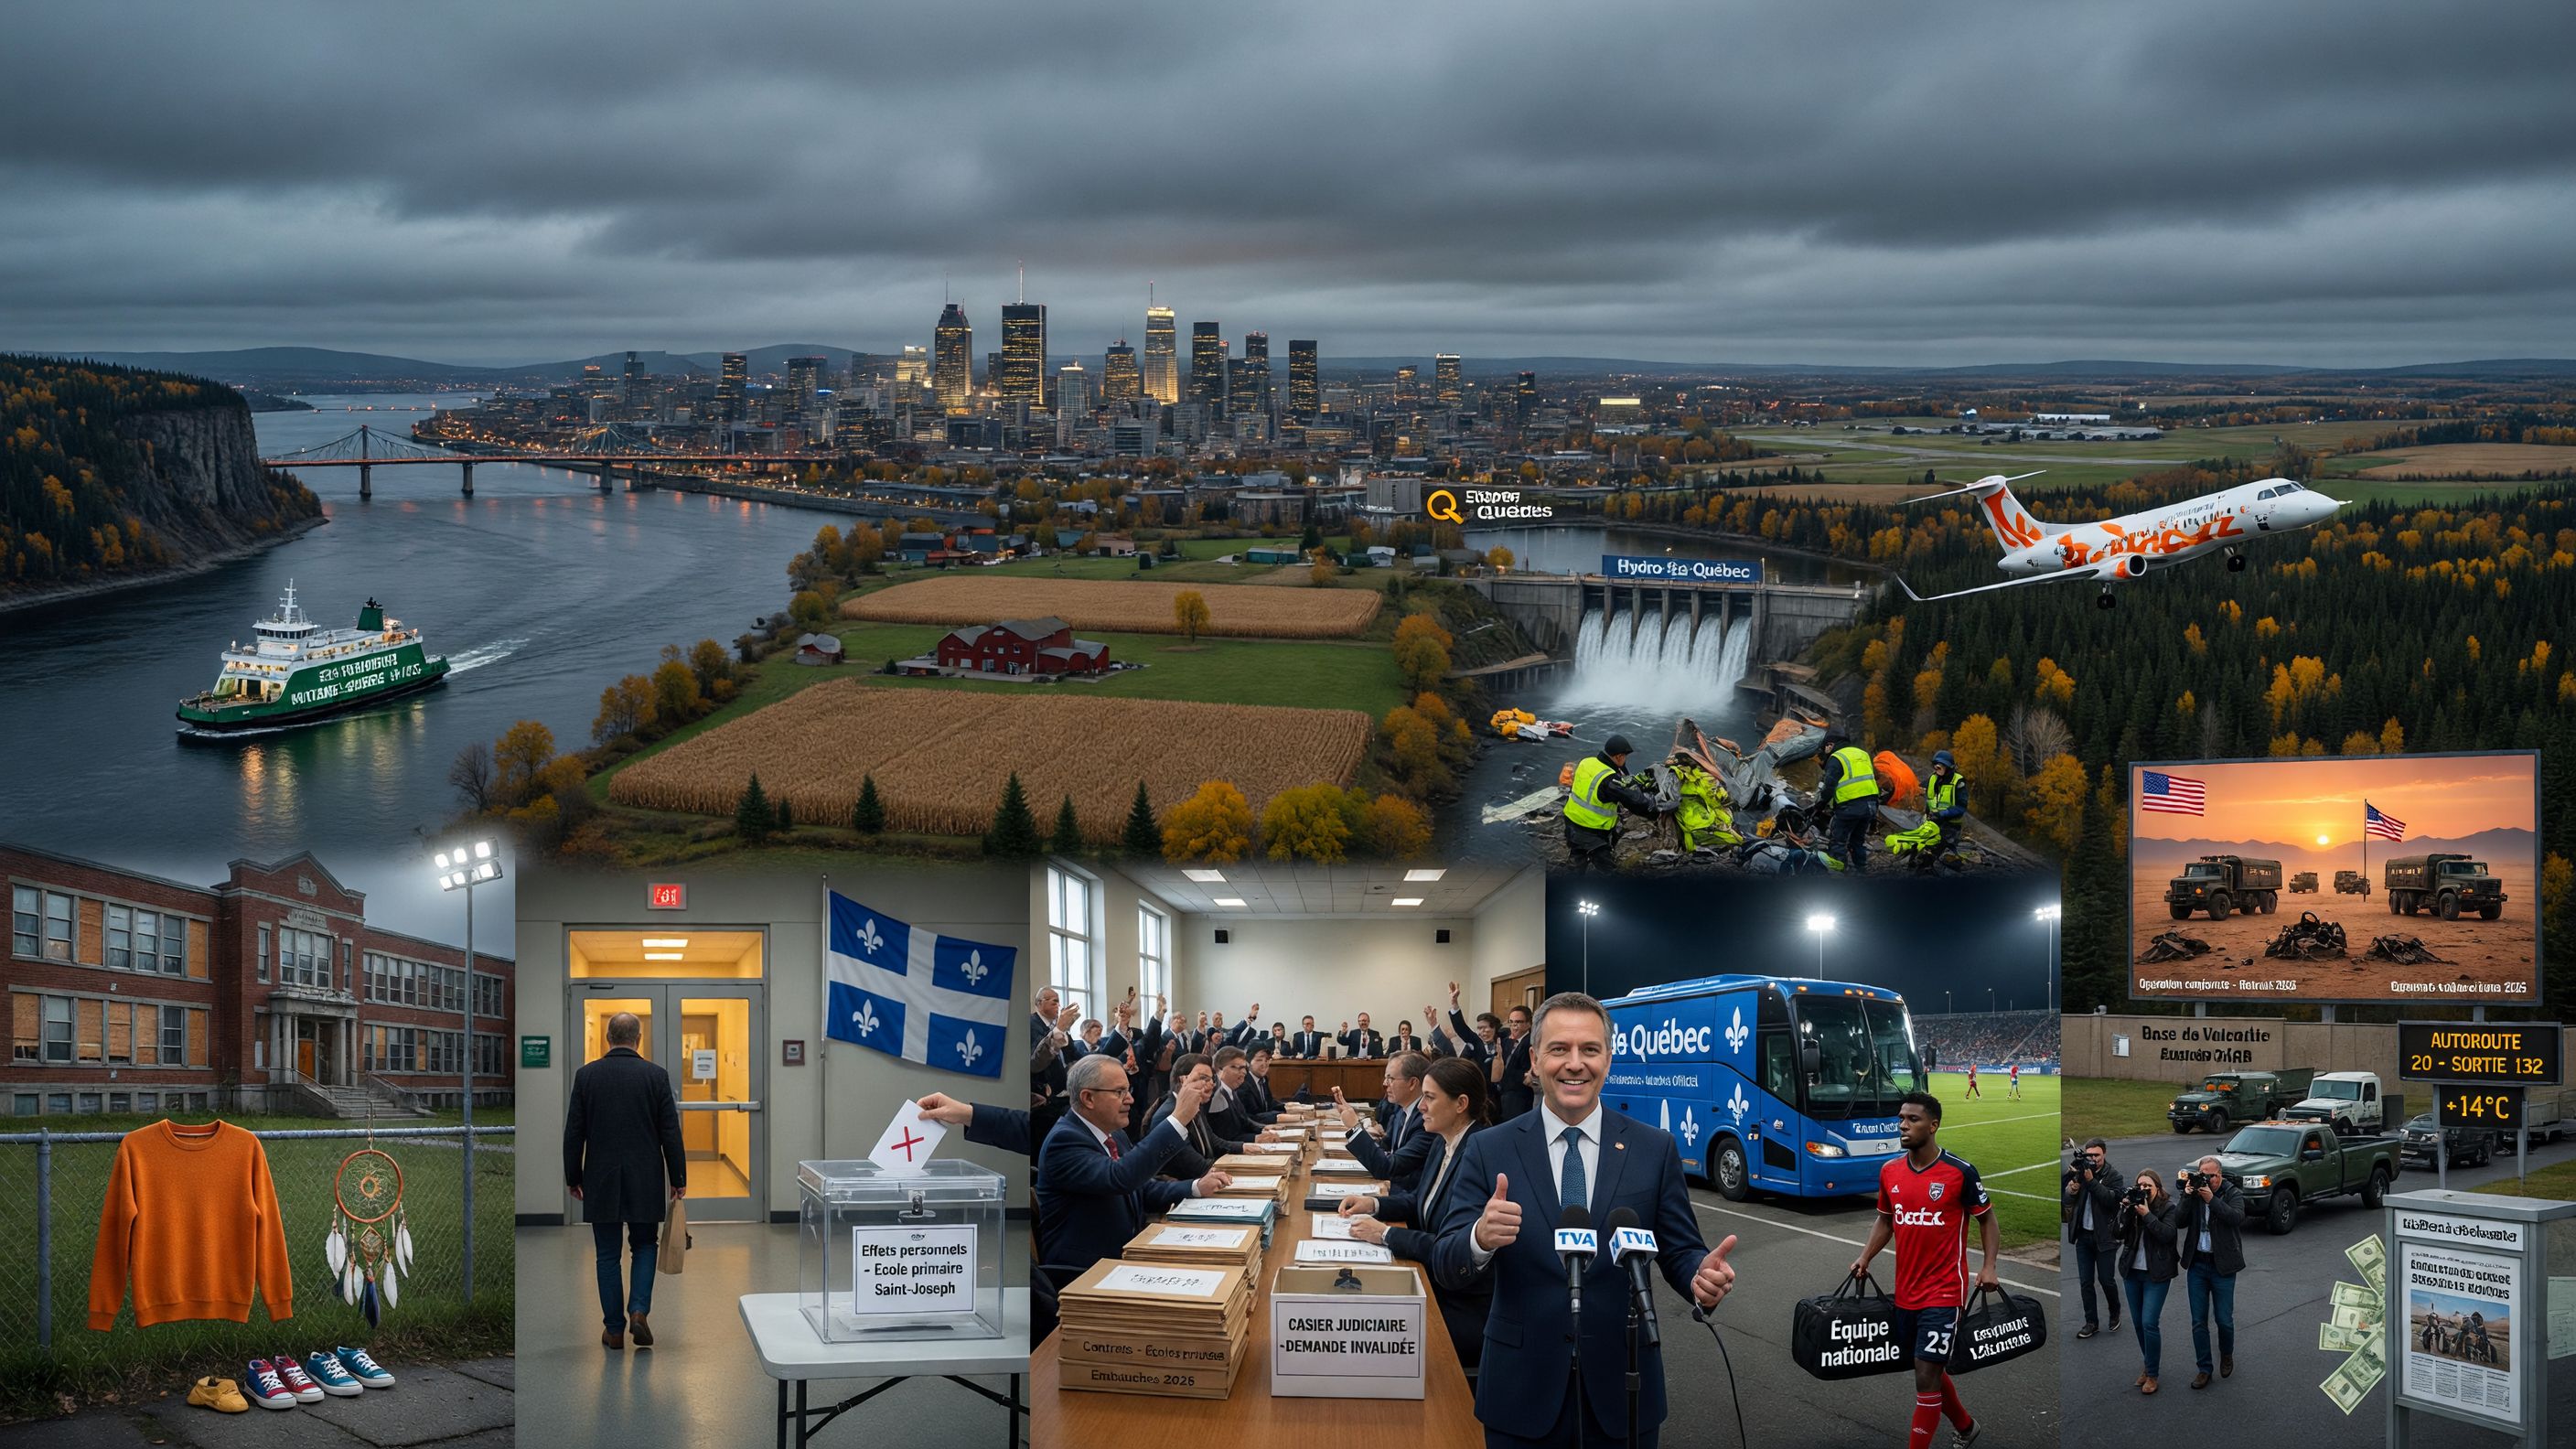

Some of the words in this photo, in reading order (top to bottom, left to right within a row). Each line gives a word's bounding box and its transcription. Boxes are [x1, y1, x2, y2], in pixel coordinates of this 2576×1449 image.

[1630, 1017, 1712, 1063] Québec
[2431, 1032, 2521, 1050] AUTOROUTE
[2411, 1055, 2432, 1071] 20
[2452, 1057, 2507, 1073] SORTIE
[2516, 1057, 2543, 1075] 132
[1558, 1231, 1595, 1248] TVA
[1622, 1230, 1656, 1248] TVA
[862, 1245, 896, 1257] Effets
[900, 1243, 968, 1259] personnels
[911, 1261, 963, 1278] primaire
[875, 1282, 955, 1297] Saint-Joseph
[1288, 1318, 1334, 1332] CASIER
[1336, 1319, 1408, 1332] JUDICIAIRE
[1830, 1316, 1889, 1344] Équipe
[1350, 1337, 1415, 1355] INVALIDÉE
[1924, 1330, 1950, 1355] 23
[1821, 1345, 1900, 1368] nationale
